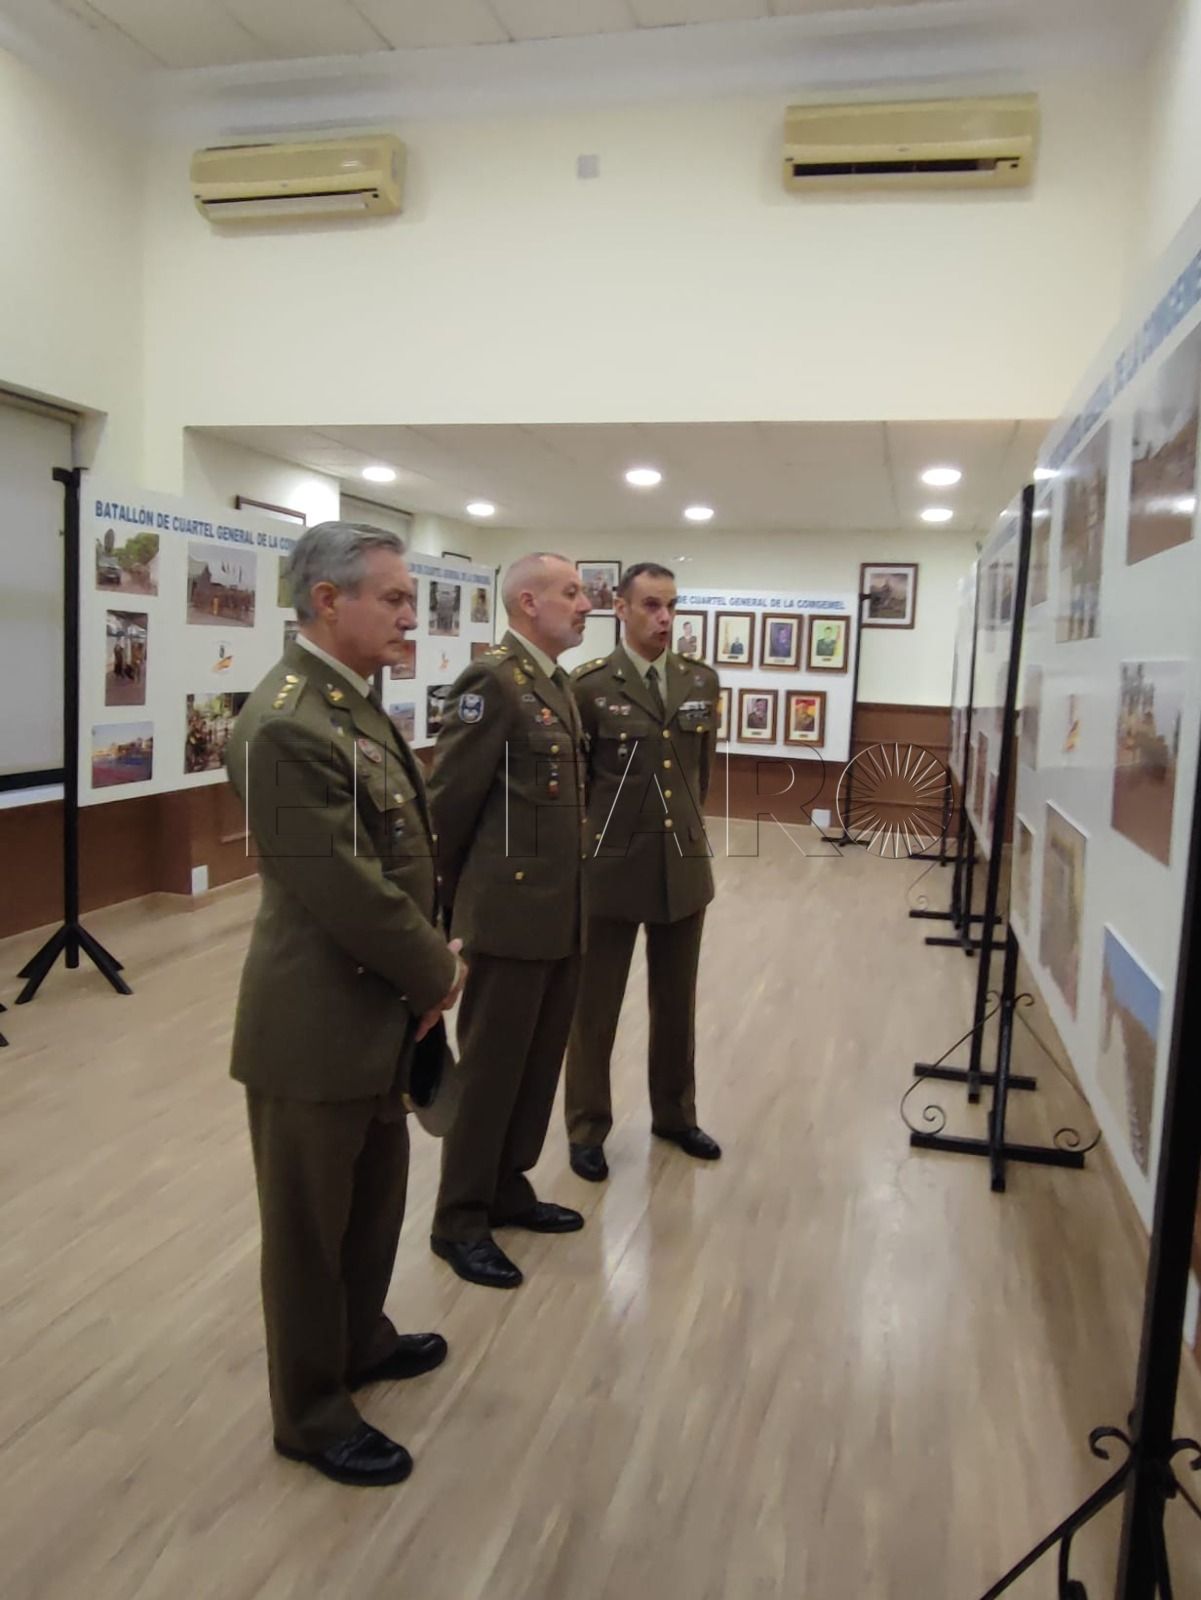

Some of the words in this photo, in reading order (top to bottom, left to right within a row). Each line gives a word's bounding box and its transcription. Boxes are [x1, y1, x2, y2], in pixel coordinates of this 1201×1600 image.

[95, 500, 154, 527] BATALLÓN
[157, 512, 170, 530] DE
[172, 516, 215, 538] CUARTEL
[216, 525, 254, 545] GENERAL
[257, 533, 268, 547] DE
[268, 535, 278, 549] LA
[690, 596, 727, 606] CUARTEL
[729, 597, 768, 607] GENERAL
[770, 598, 781, 608] DE
[783, 599, 795, 608] LA
